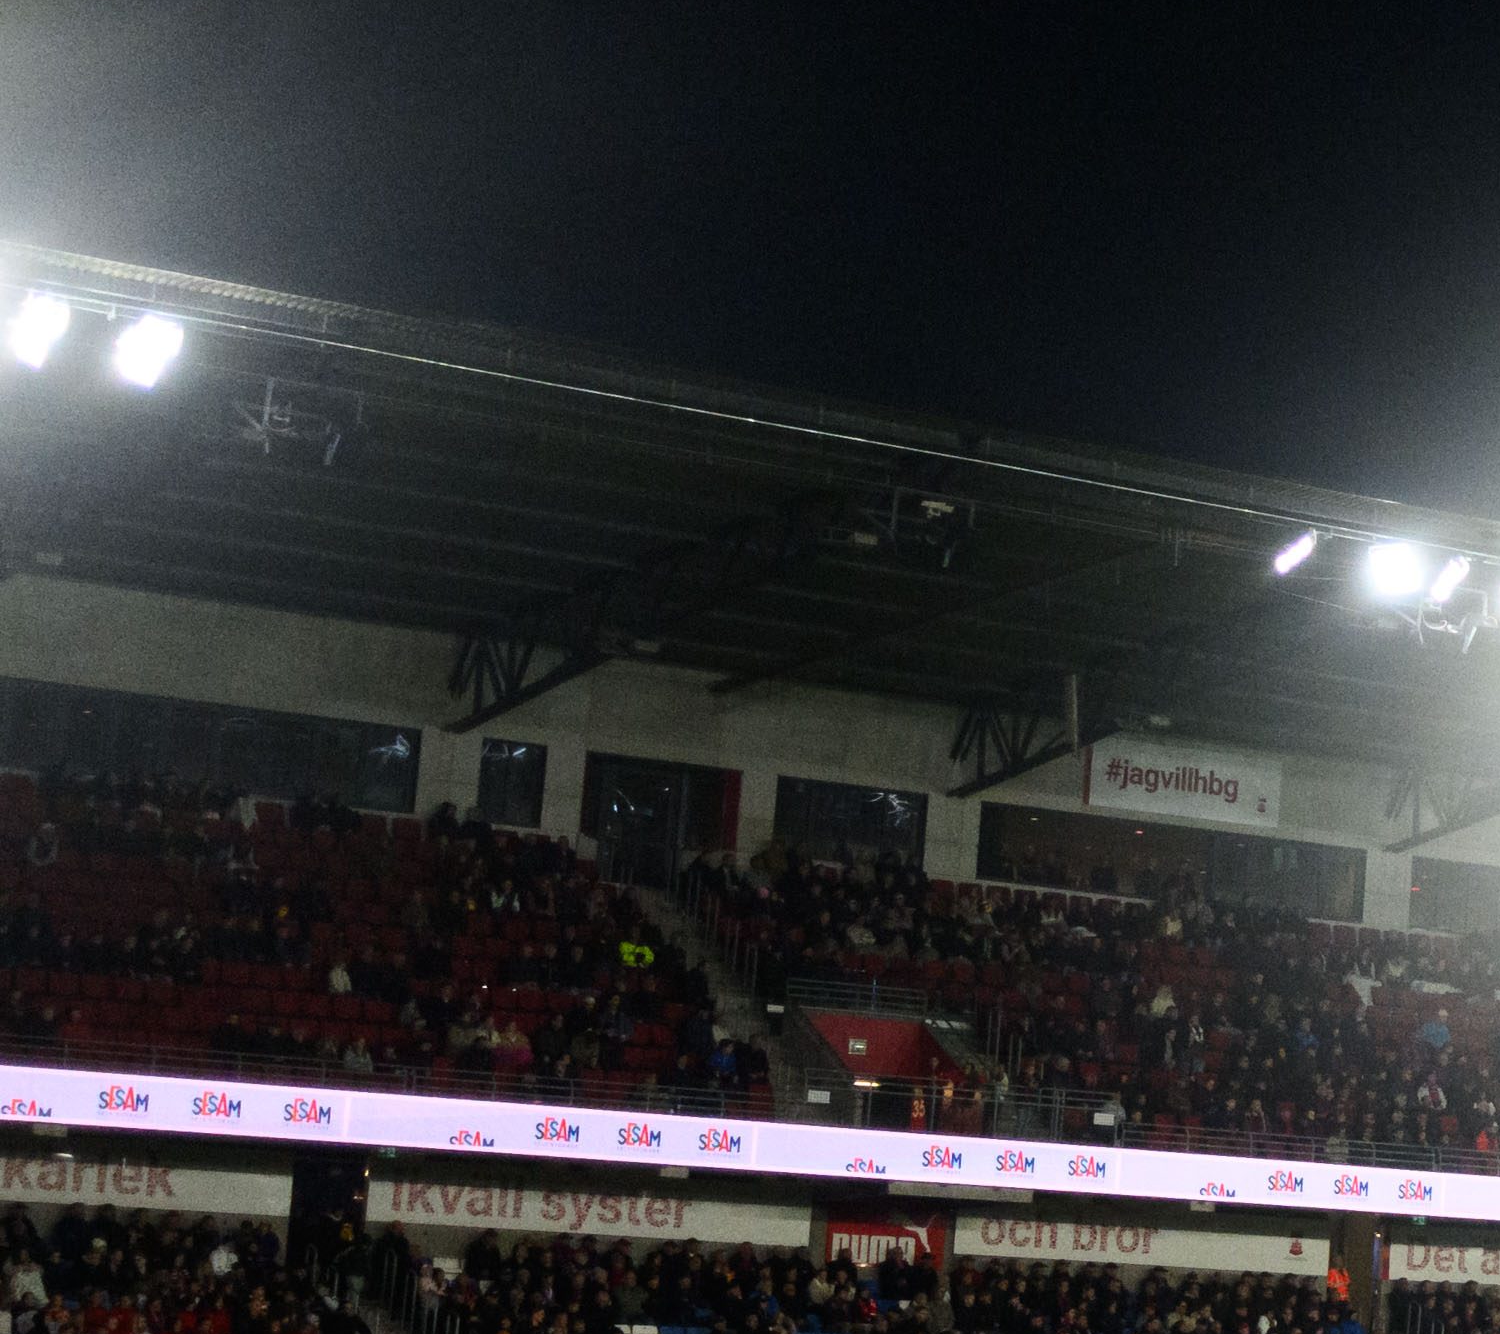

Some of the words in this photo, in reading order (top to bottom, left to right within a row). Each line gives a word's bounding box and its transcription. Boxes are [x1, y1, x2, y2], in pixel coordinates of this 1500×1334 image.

[1105, 756, 1240, 804] #jagvillhbg
[99, 1086, 149, 1112] SESAM
[192, 1092, 241, 1118] SESAM
[284, 1098, 331, 1125] SESAM
[535, 1117, 579, 1143] SESAM
[618, 1122, 661, 1148] SESAM
[699, 1128, 741, 1153] SESAM
[922, 1145, 962, 1170] SESAM
[996, 1150, 1035, 1173] SESAM
[1069, 1155, 1105, 1178] SESAM
[1268, 1170, 1303, 1193] SESAM
[1334, 1174, 1368, 1197] SESAM
[1399, 1179, 1432, 1201] SESAM
[831, 1231, 916, 1267] PUMA
